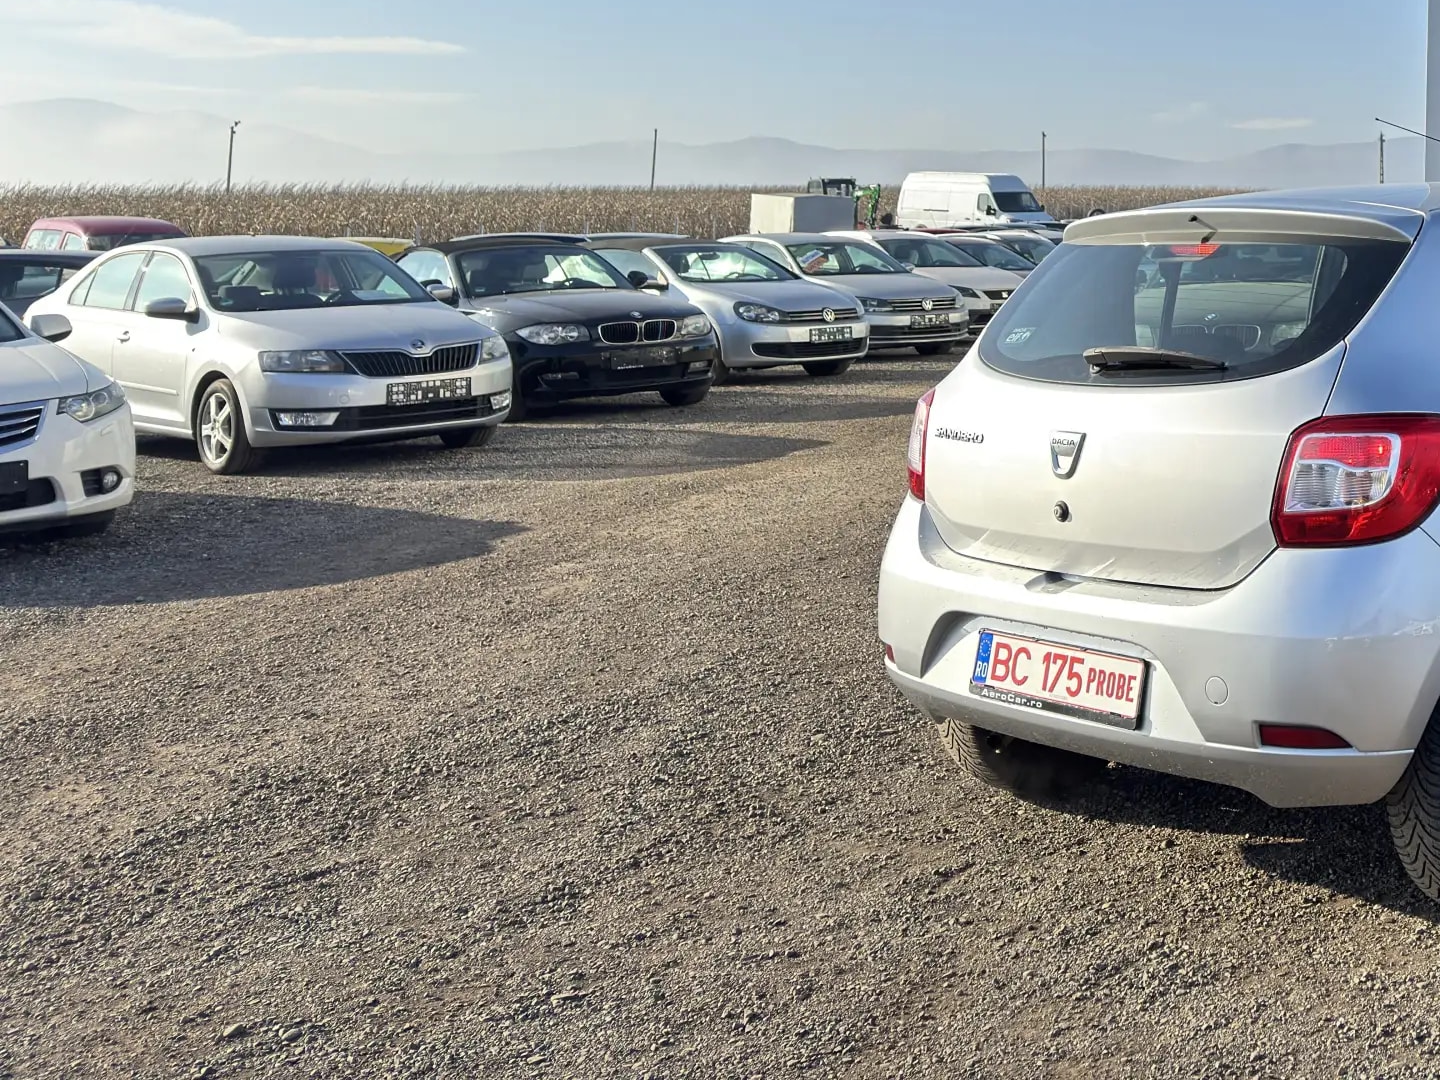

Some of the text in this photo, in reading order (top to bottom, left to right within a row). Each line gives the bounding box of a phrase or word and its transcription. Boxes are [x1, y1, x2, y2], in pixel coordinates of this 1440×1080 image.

[1051, 437, 1076, 446] DACIA
[975, 642, 1137, 703] RO BC 175 PROBE
[981, 688, 1043, 708] AeroCar.ro
